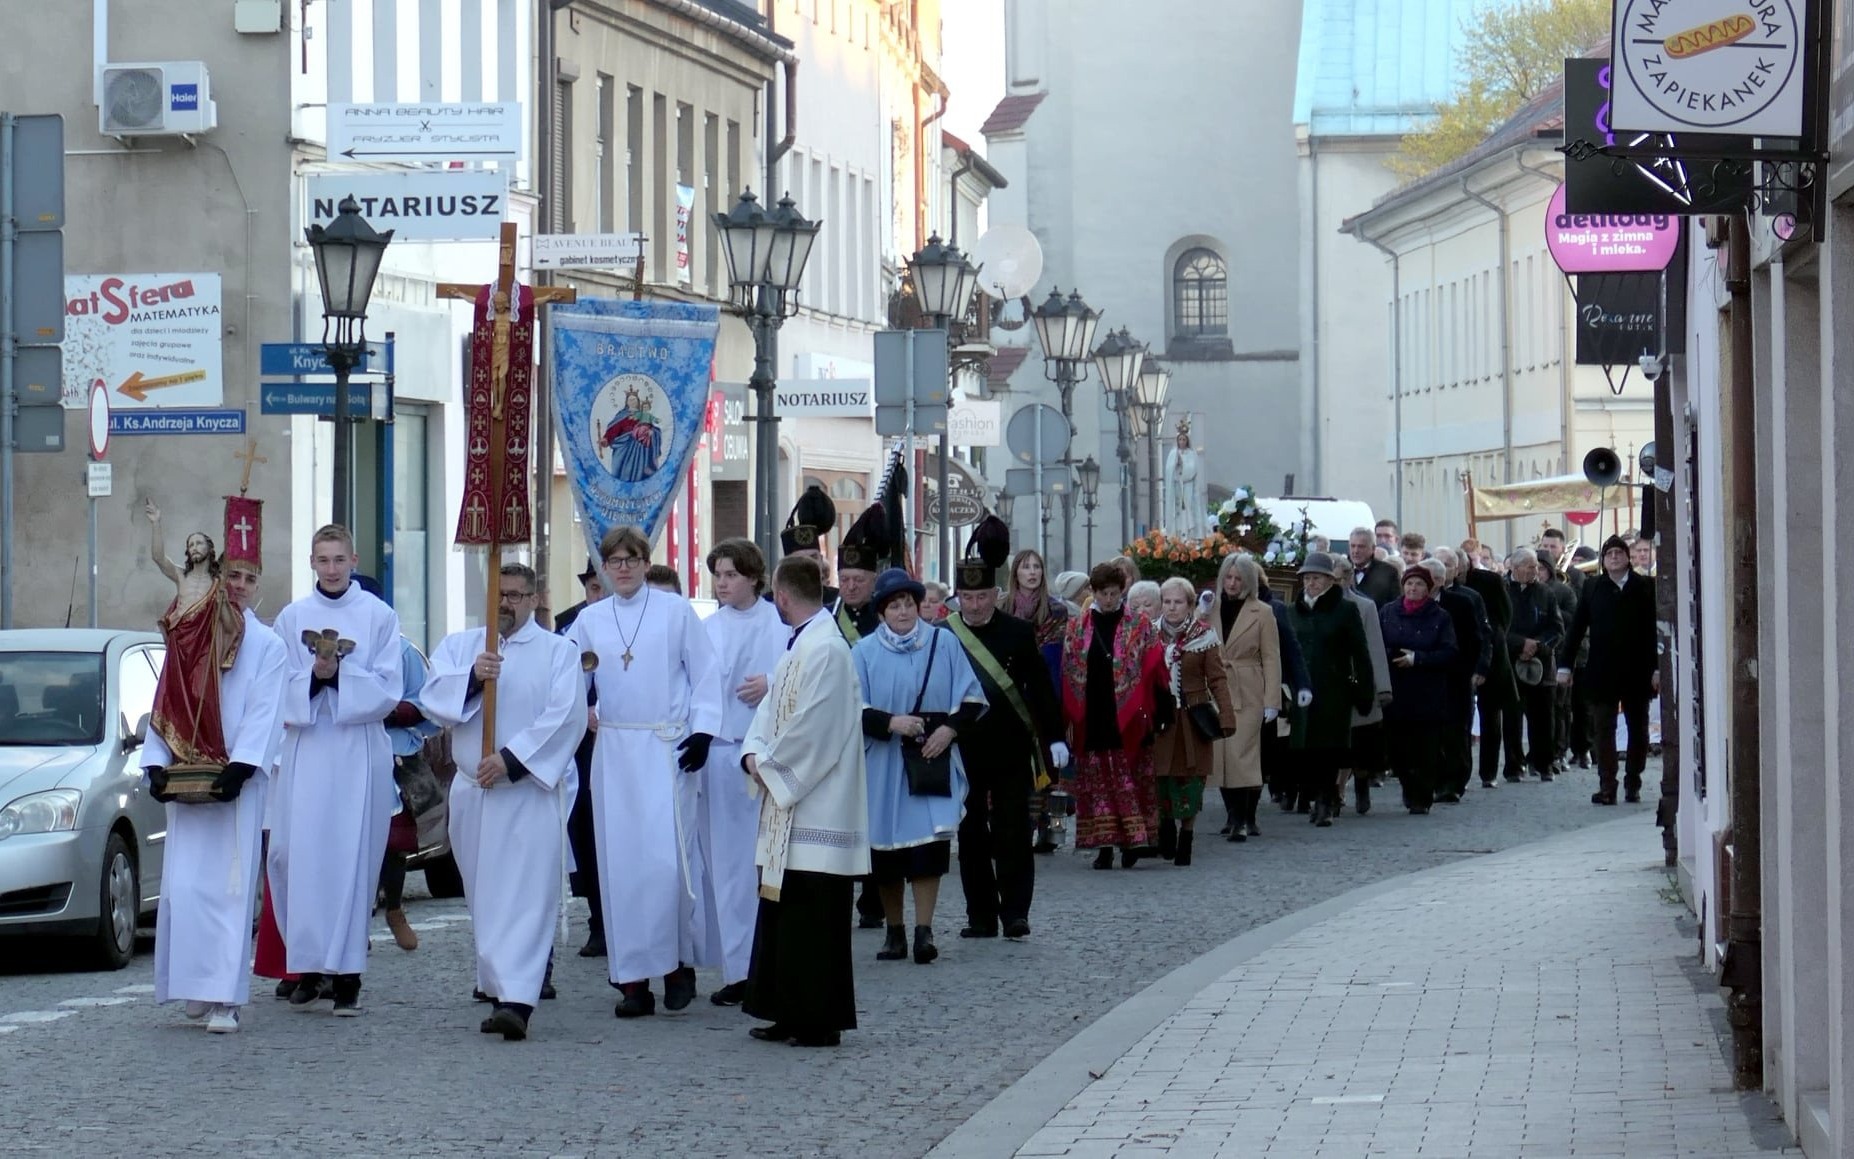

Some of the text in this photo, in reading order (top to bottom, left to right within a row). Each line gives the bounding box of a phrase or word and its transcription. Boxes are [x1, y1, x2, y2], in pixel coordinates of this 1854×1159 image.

[1642, 54, 1776, 111] ZAPIEKANEK
[171, 93, 197, 102] Haier
[345, 107, 504, 116] ANNA BEAUTY HAIR
[430, 135, 500, 143] STYLISTA
[1558, 229, 1654, 246] Magia z zimna
[1592, 243, 1597, 255] i
[559, 254, 637, 267] gabinet kosmetyczn
[130, 305, 220, 323] MATEMATYKA
[130, 327, 144, 335] dla
[144, 327, 167, 335] dzieci
[159, 341, 192, 351] grupowe
[596, 343, 668, 361] BRACTWO
[129, 352, 196, 365] oraz indywidualne
[287, 394, 325, 406] Bulwary
[777, 391, 868, 407] NOTARIUSZ
[123, 416, 193, 431] Ks.Andrzeja
[196, 415, 239, 432] Knycza
